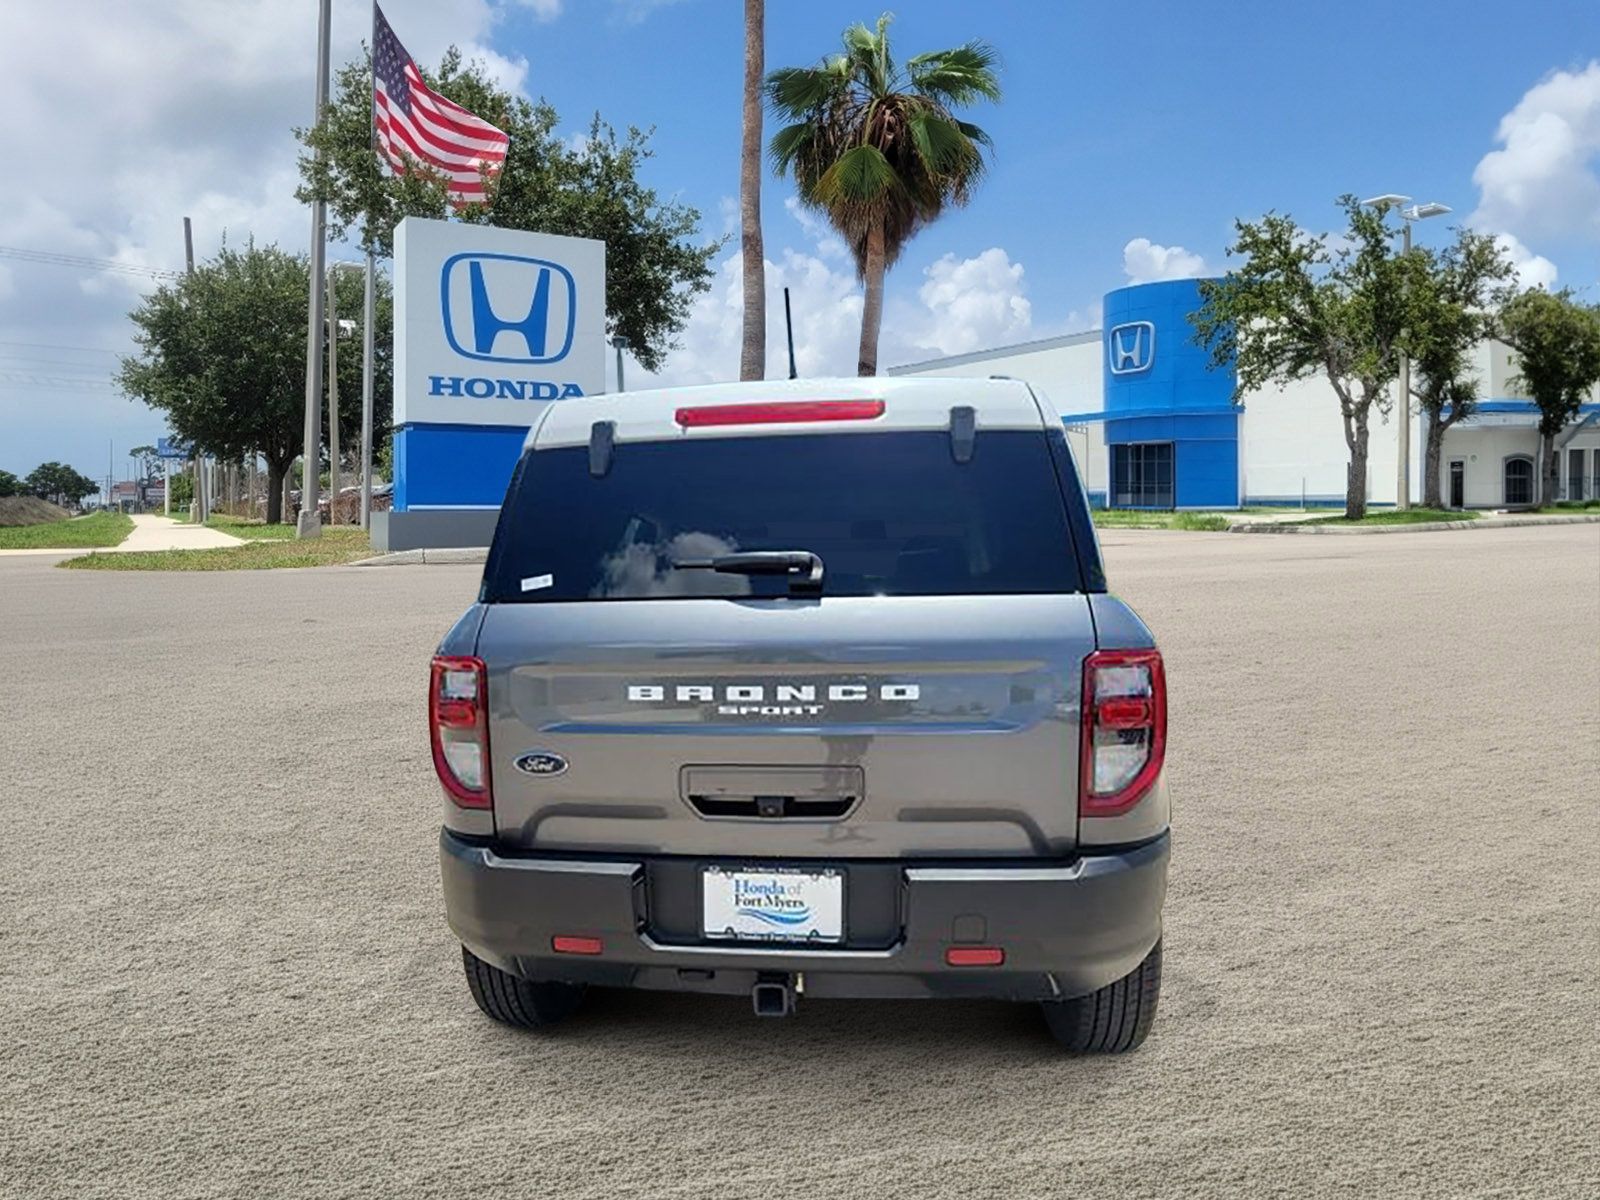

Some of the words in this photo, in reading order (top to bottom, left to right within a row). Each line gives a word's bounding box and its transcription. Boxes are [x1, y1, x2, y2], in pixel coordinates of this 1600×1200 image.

[428, 376, 584, 401] HONDA
[628, 684, 920, 701] BRONCO
[718, 704, 824, 716] SPORT
[734, 879, 785, 895] Honda
[786, 880, 805, 897] of
[734, 893, 762, 907] Fort
[764, 894, 805, 912] Myers
